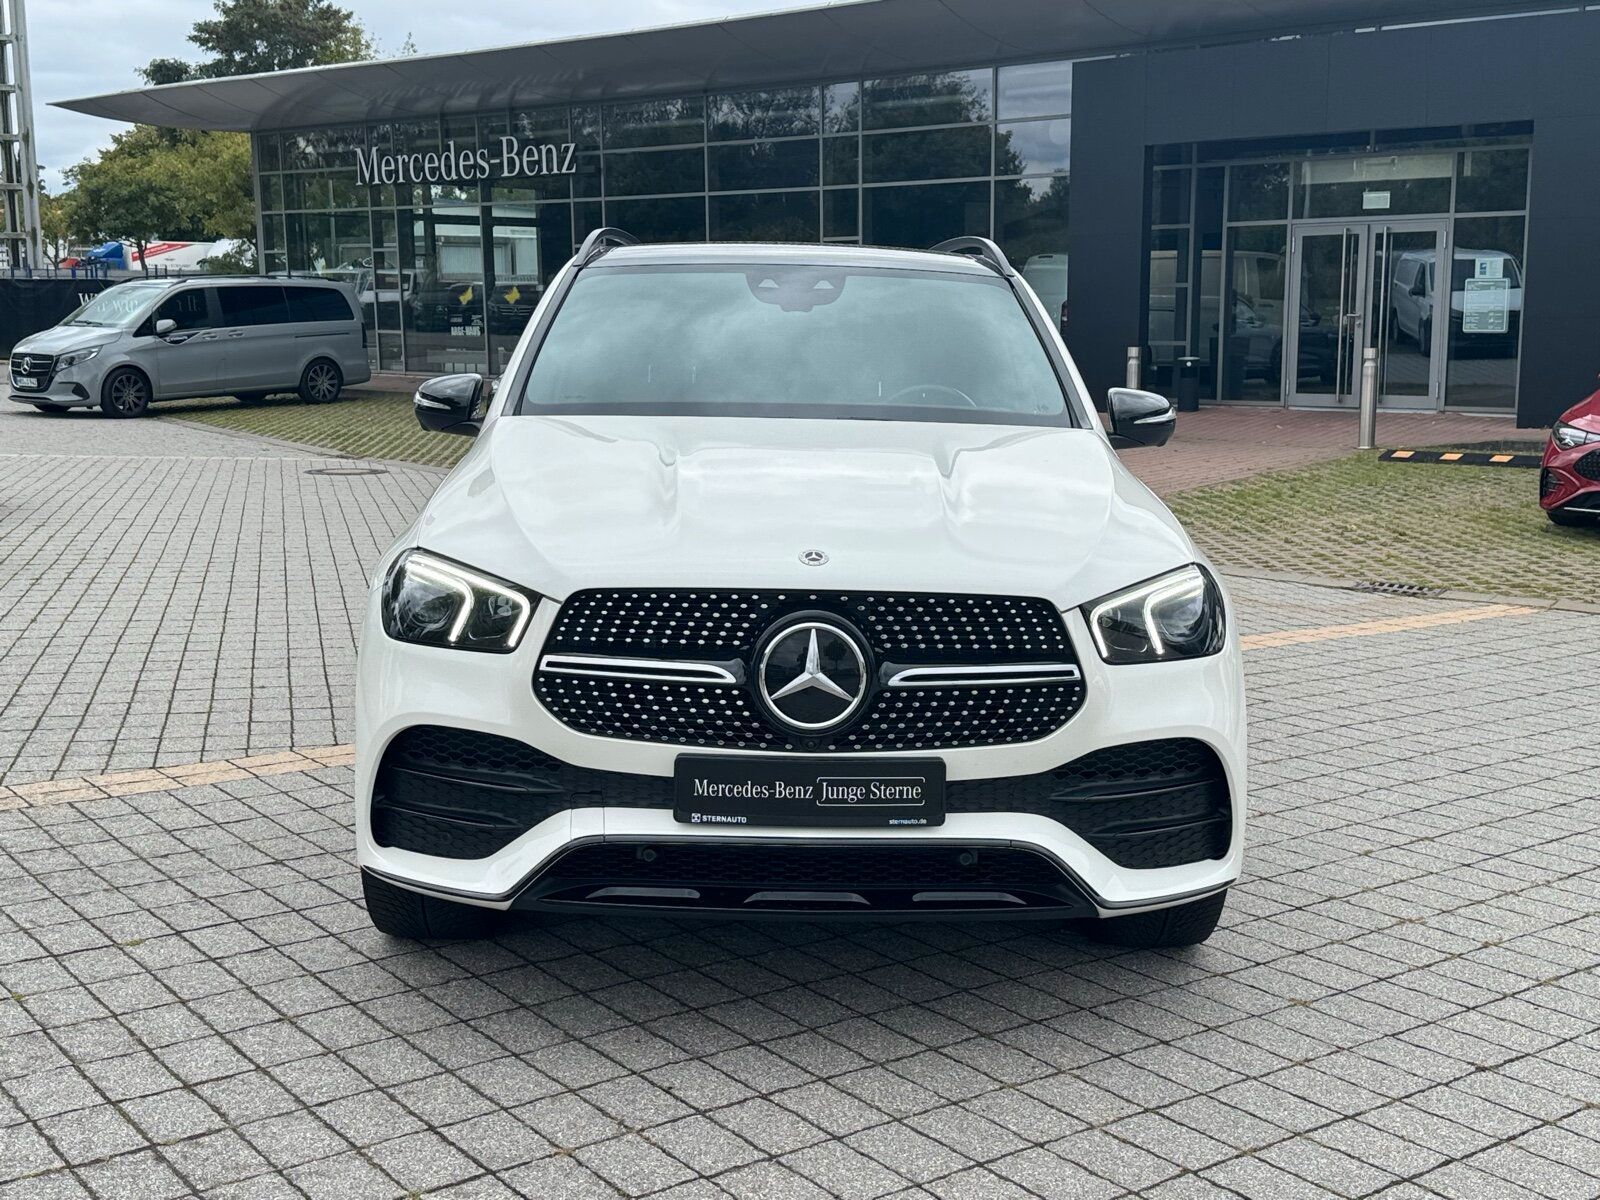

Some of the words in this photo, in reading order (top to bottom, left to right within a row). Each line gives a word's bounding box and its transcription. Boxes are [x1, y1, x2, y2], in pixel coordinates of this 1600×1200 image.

[354, 136, 577, 186] Mercedes-Benz
[693, 778, 814, 799] Mercedes-Benz
[820, 782, 865, 803] Junge
[869, 782, 922, 799] Sterne
[702, 814, 747, 824] STERNAUTO
